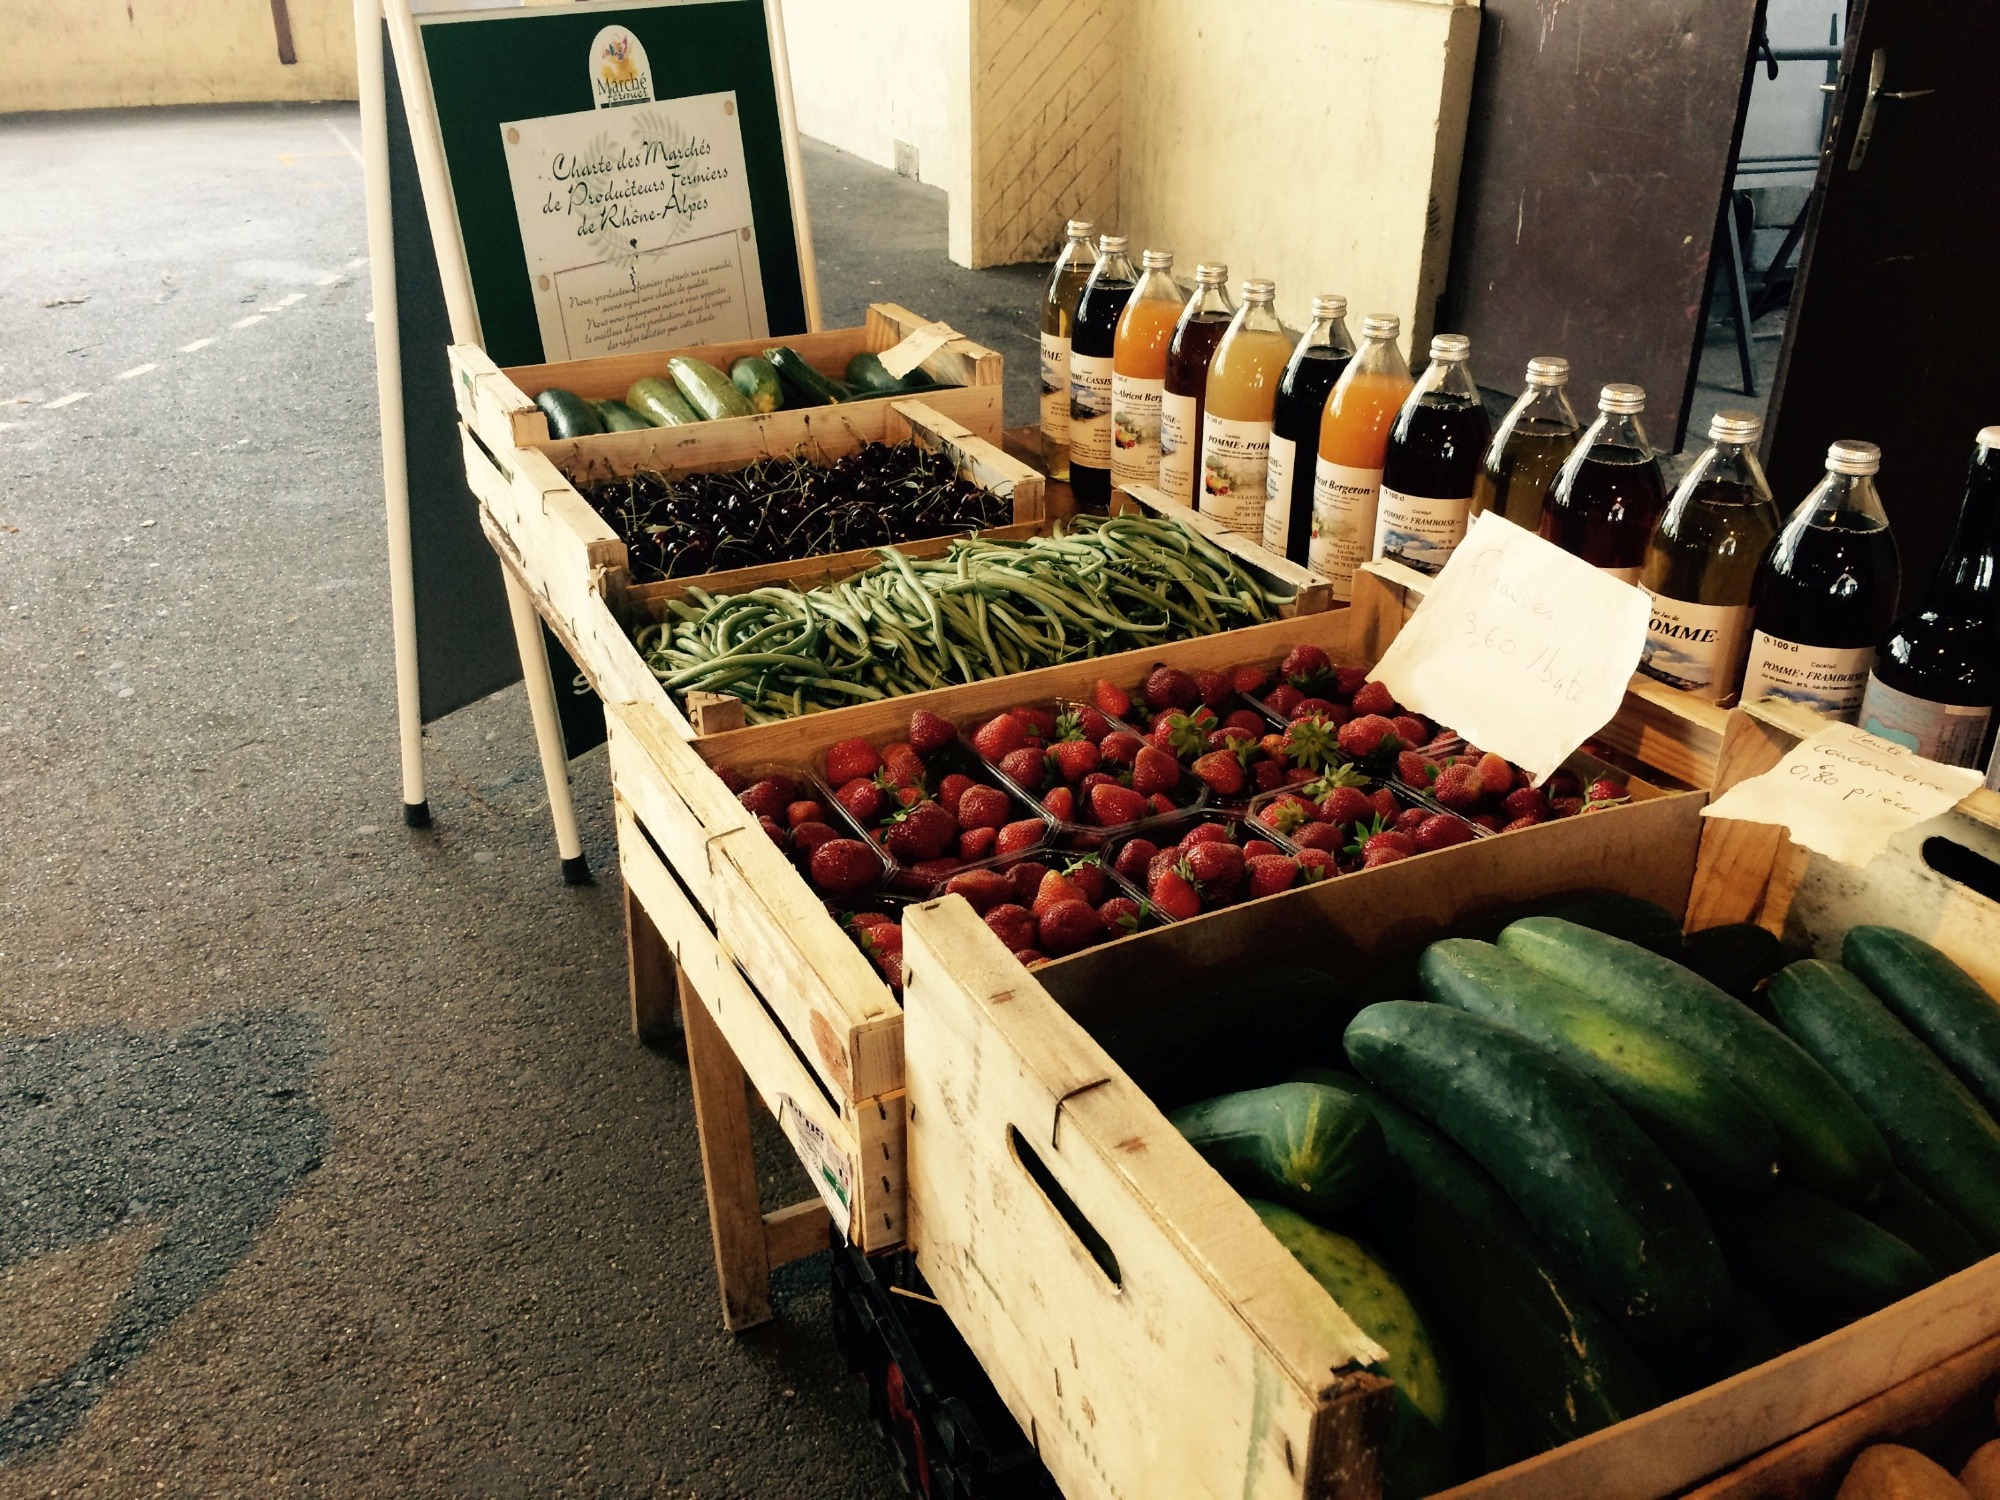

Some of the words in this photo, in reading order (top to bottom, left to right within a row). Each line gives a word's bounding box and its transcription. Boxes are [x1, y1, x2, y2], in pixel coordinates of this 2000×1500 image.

[597, 72, 648, 96] Marché
[552, 153, 613, 180] Charte
[617, 147, 641, 172] des
[642, 136, 711, 165] Marchés
[543, 192, 562, 214] de
[568, 178, 665, 215] Producteurs
[666, 164, 729, 196] Fermiers
[577, 216, 597, 236] de
[600, 194, 709, 231] Rhône-Alpes
[1041, 348, 1062, 361] MME
[1119, 389, 1143, 401] Abricot
[1144, 393, 1162, 403] Berg
[1208, 435, 1240, 450] POMME
[1328, 479, 1371, 496] Bergeron
[1648, 618, 1718, 644] OMME
[1773, 639, 1789, 651] 100
[1790, 643, 1799, 653] cl
[1762, 660, 1800, 678] POMME
[1806, 671, 1867, 683] FRAMBOISE
[1810, 661, 1838, 670] Cocktail
